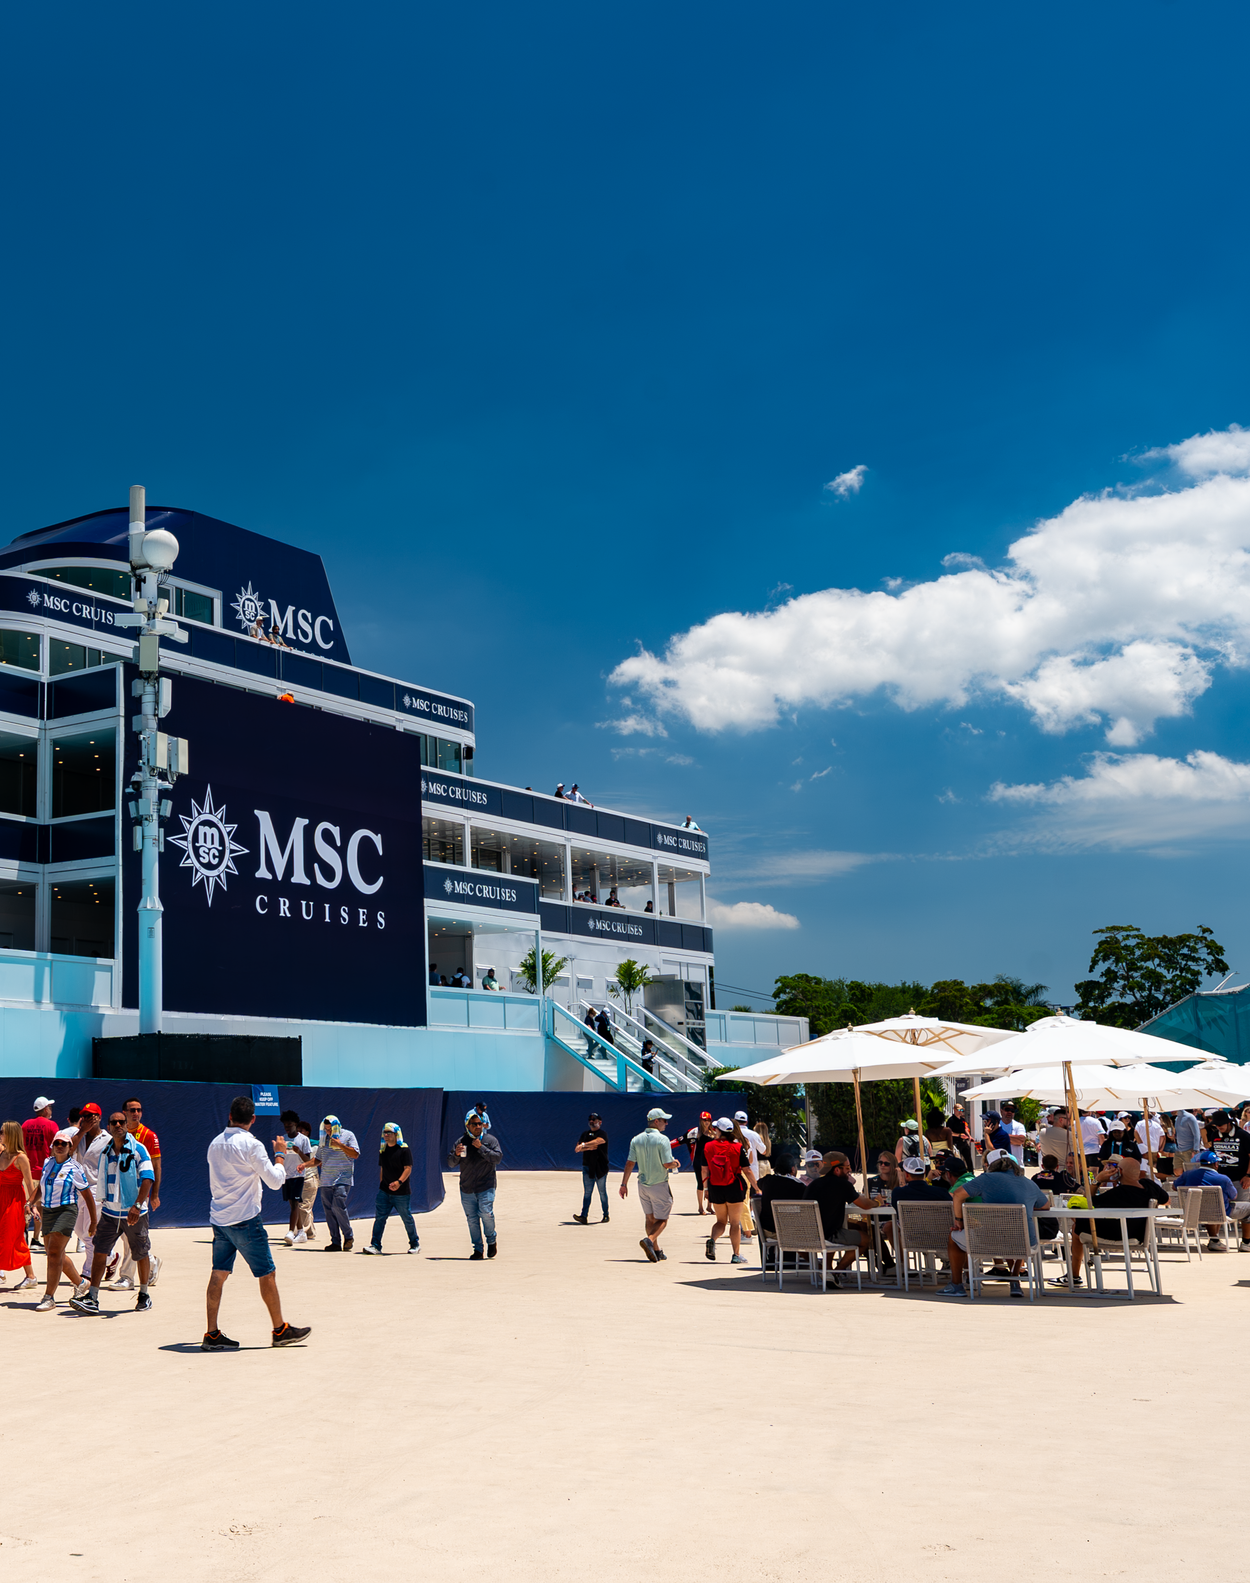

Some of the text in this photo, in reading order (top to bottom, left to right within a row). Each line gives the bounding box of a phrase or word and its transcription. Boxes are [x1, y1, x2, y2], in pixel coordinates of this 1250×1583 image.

[43, 594, 116, 625] MSC CRUIS
[268, 599, 334, 649] MSC
[412, 697, 468, 723] MSC CRUISES
[428, 782, 488, 805] MSC CRUISES
[253, 809, 384, 894] MSC
[663, 834, 706, 853] MSC CRUISES
[454, 880, 517, 902] MSC CRUISES
[255, 894, 386, 930] CRUISES
[595, 919, 643, 936] MSC CRUISES
